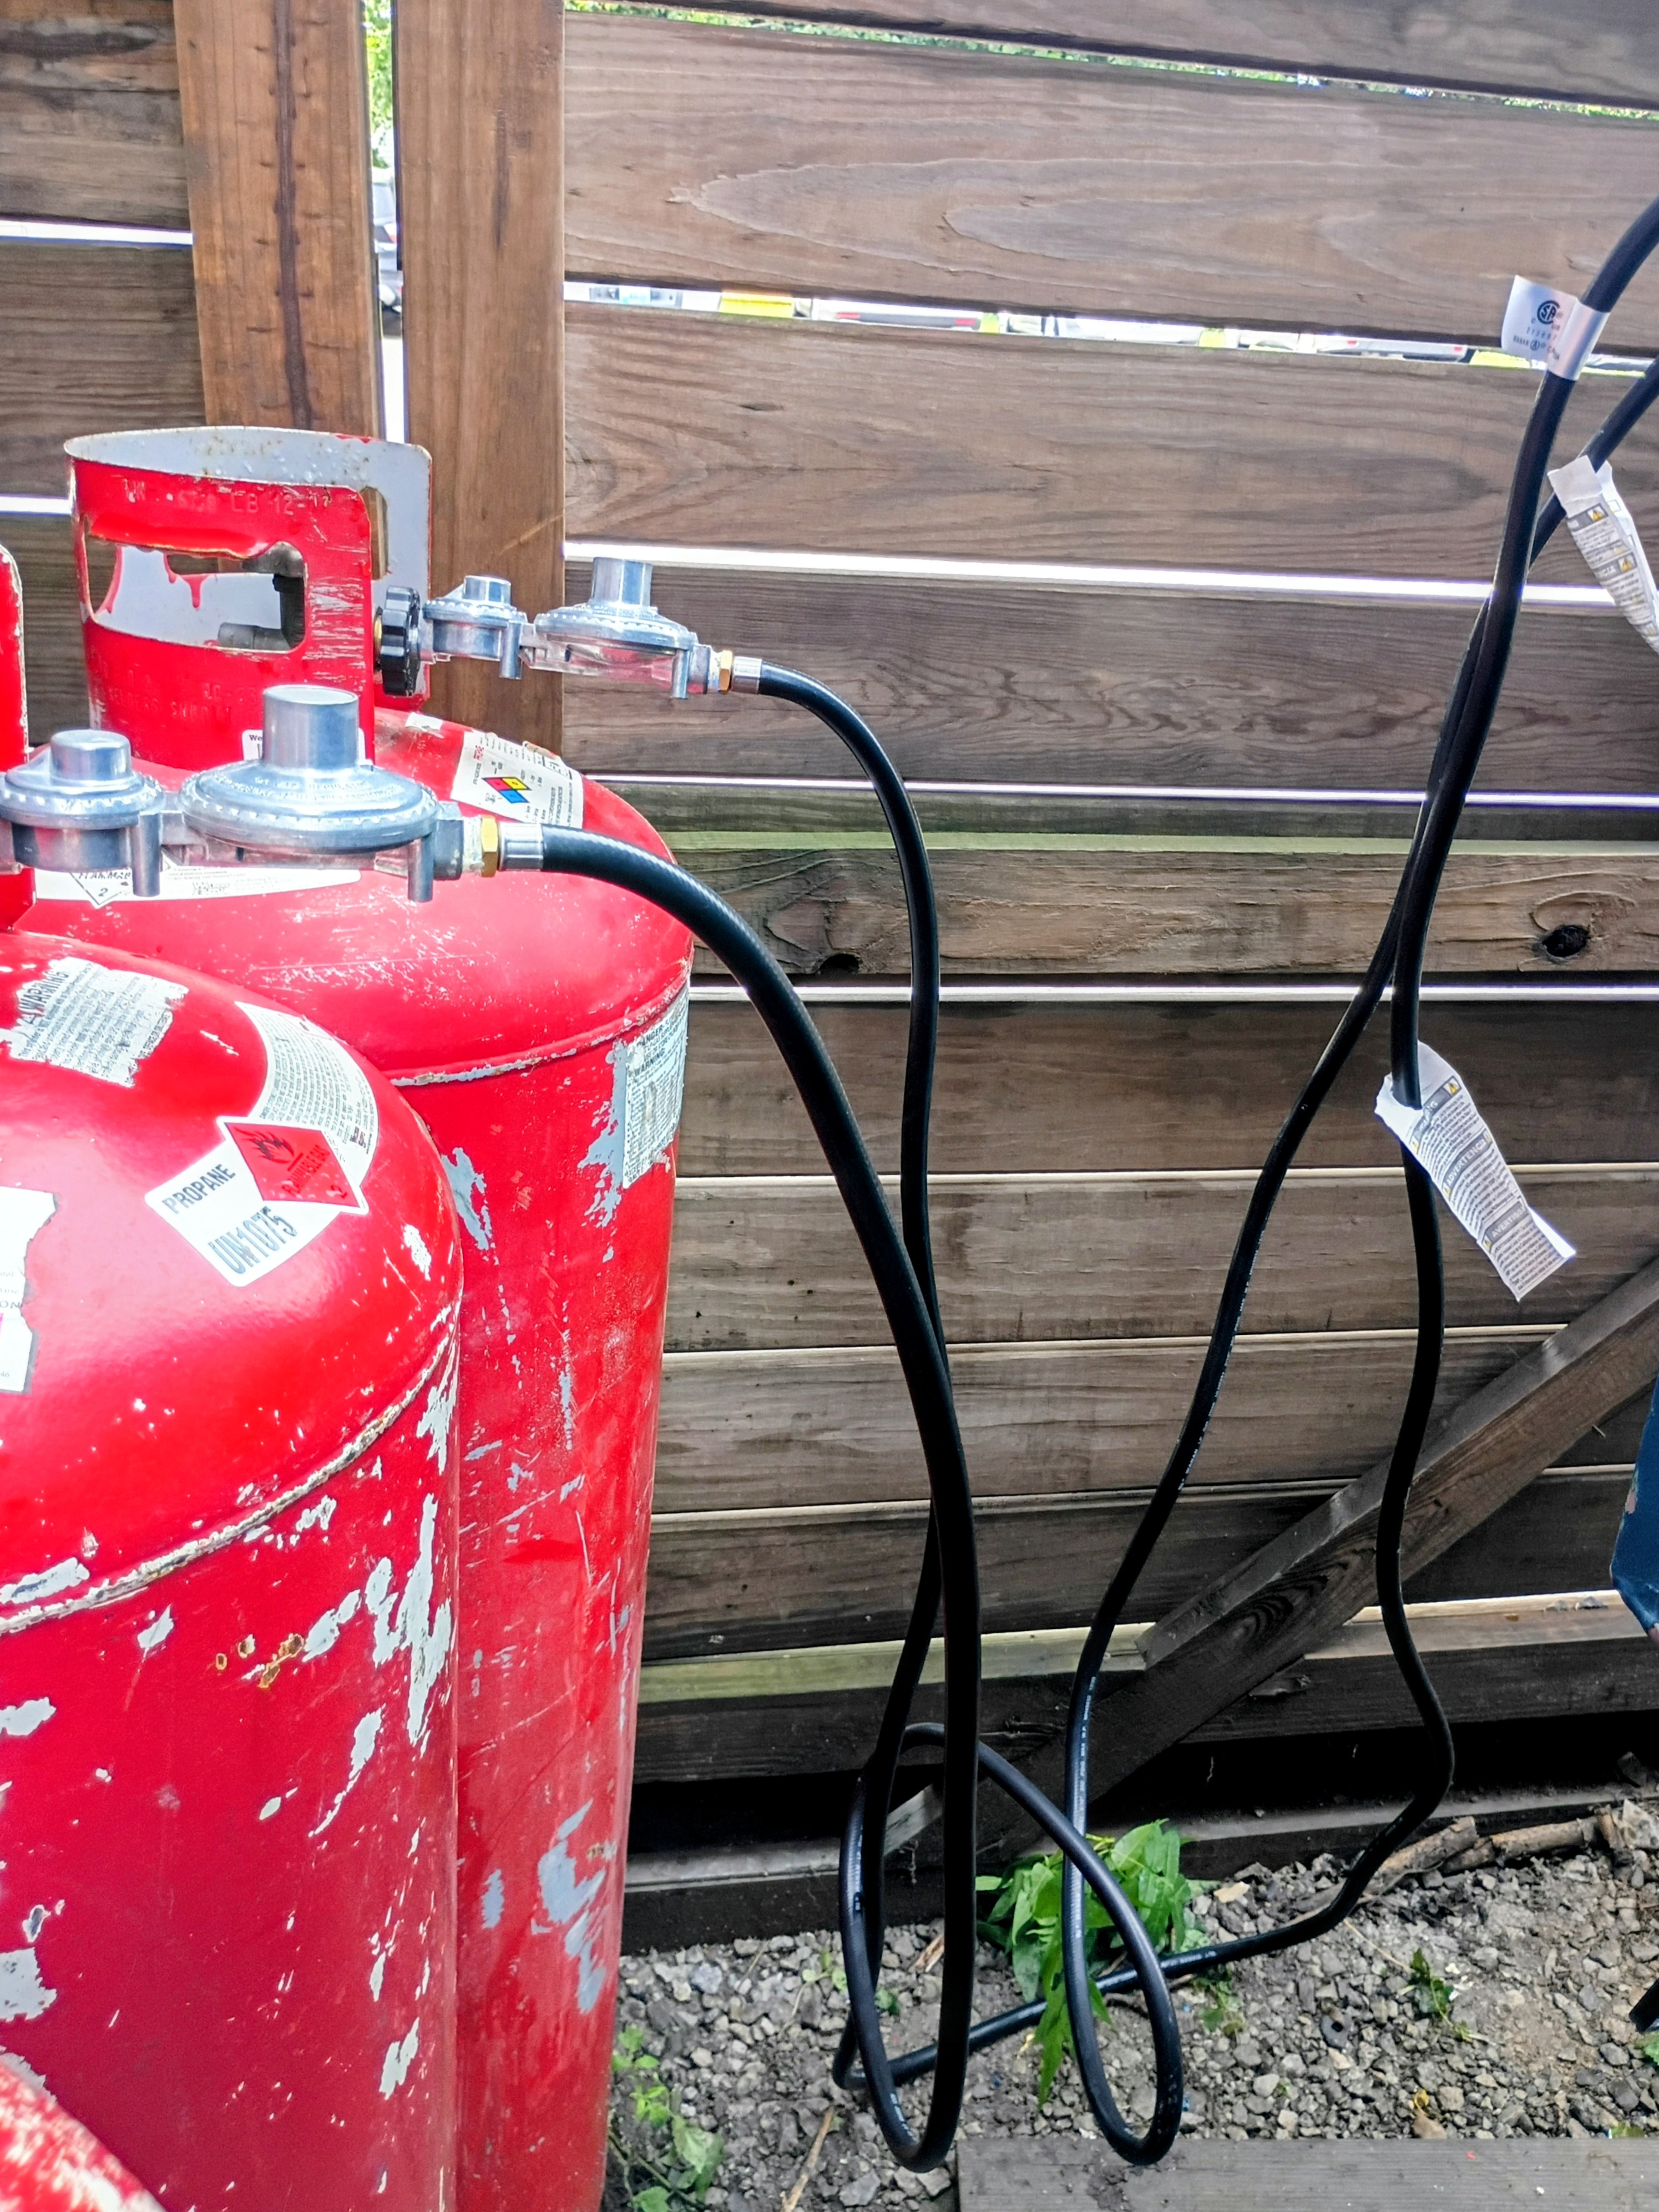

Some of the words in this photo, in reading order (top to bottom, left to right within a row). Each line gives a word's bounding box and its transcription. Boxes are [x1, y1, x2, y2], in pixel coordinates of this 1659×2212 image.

[98, 887, 109, 897] 2
[162, 1163, 236, 1214] PROPANE
[281, 1156, 322, 1197] FLAMMABLE
[310, 1145, 331, 1161] GAS
[207, 1206, 298, 1275] UN1075
